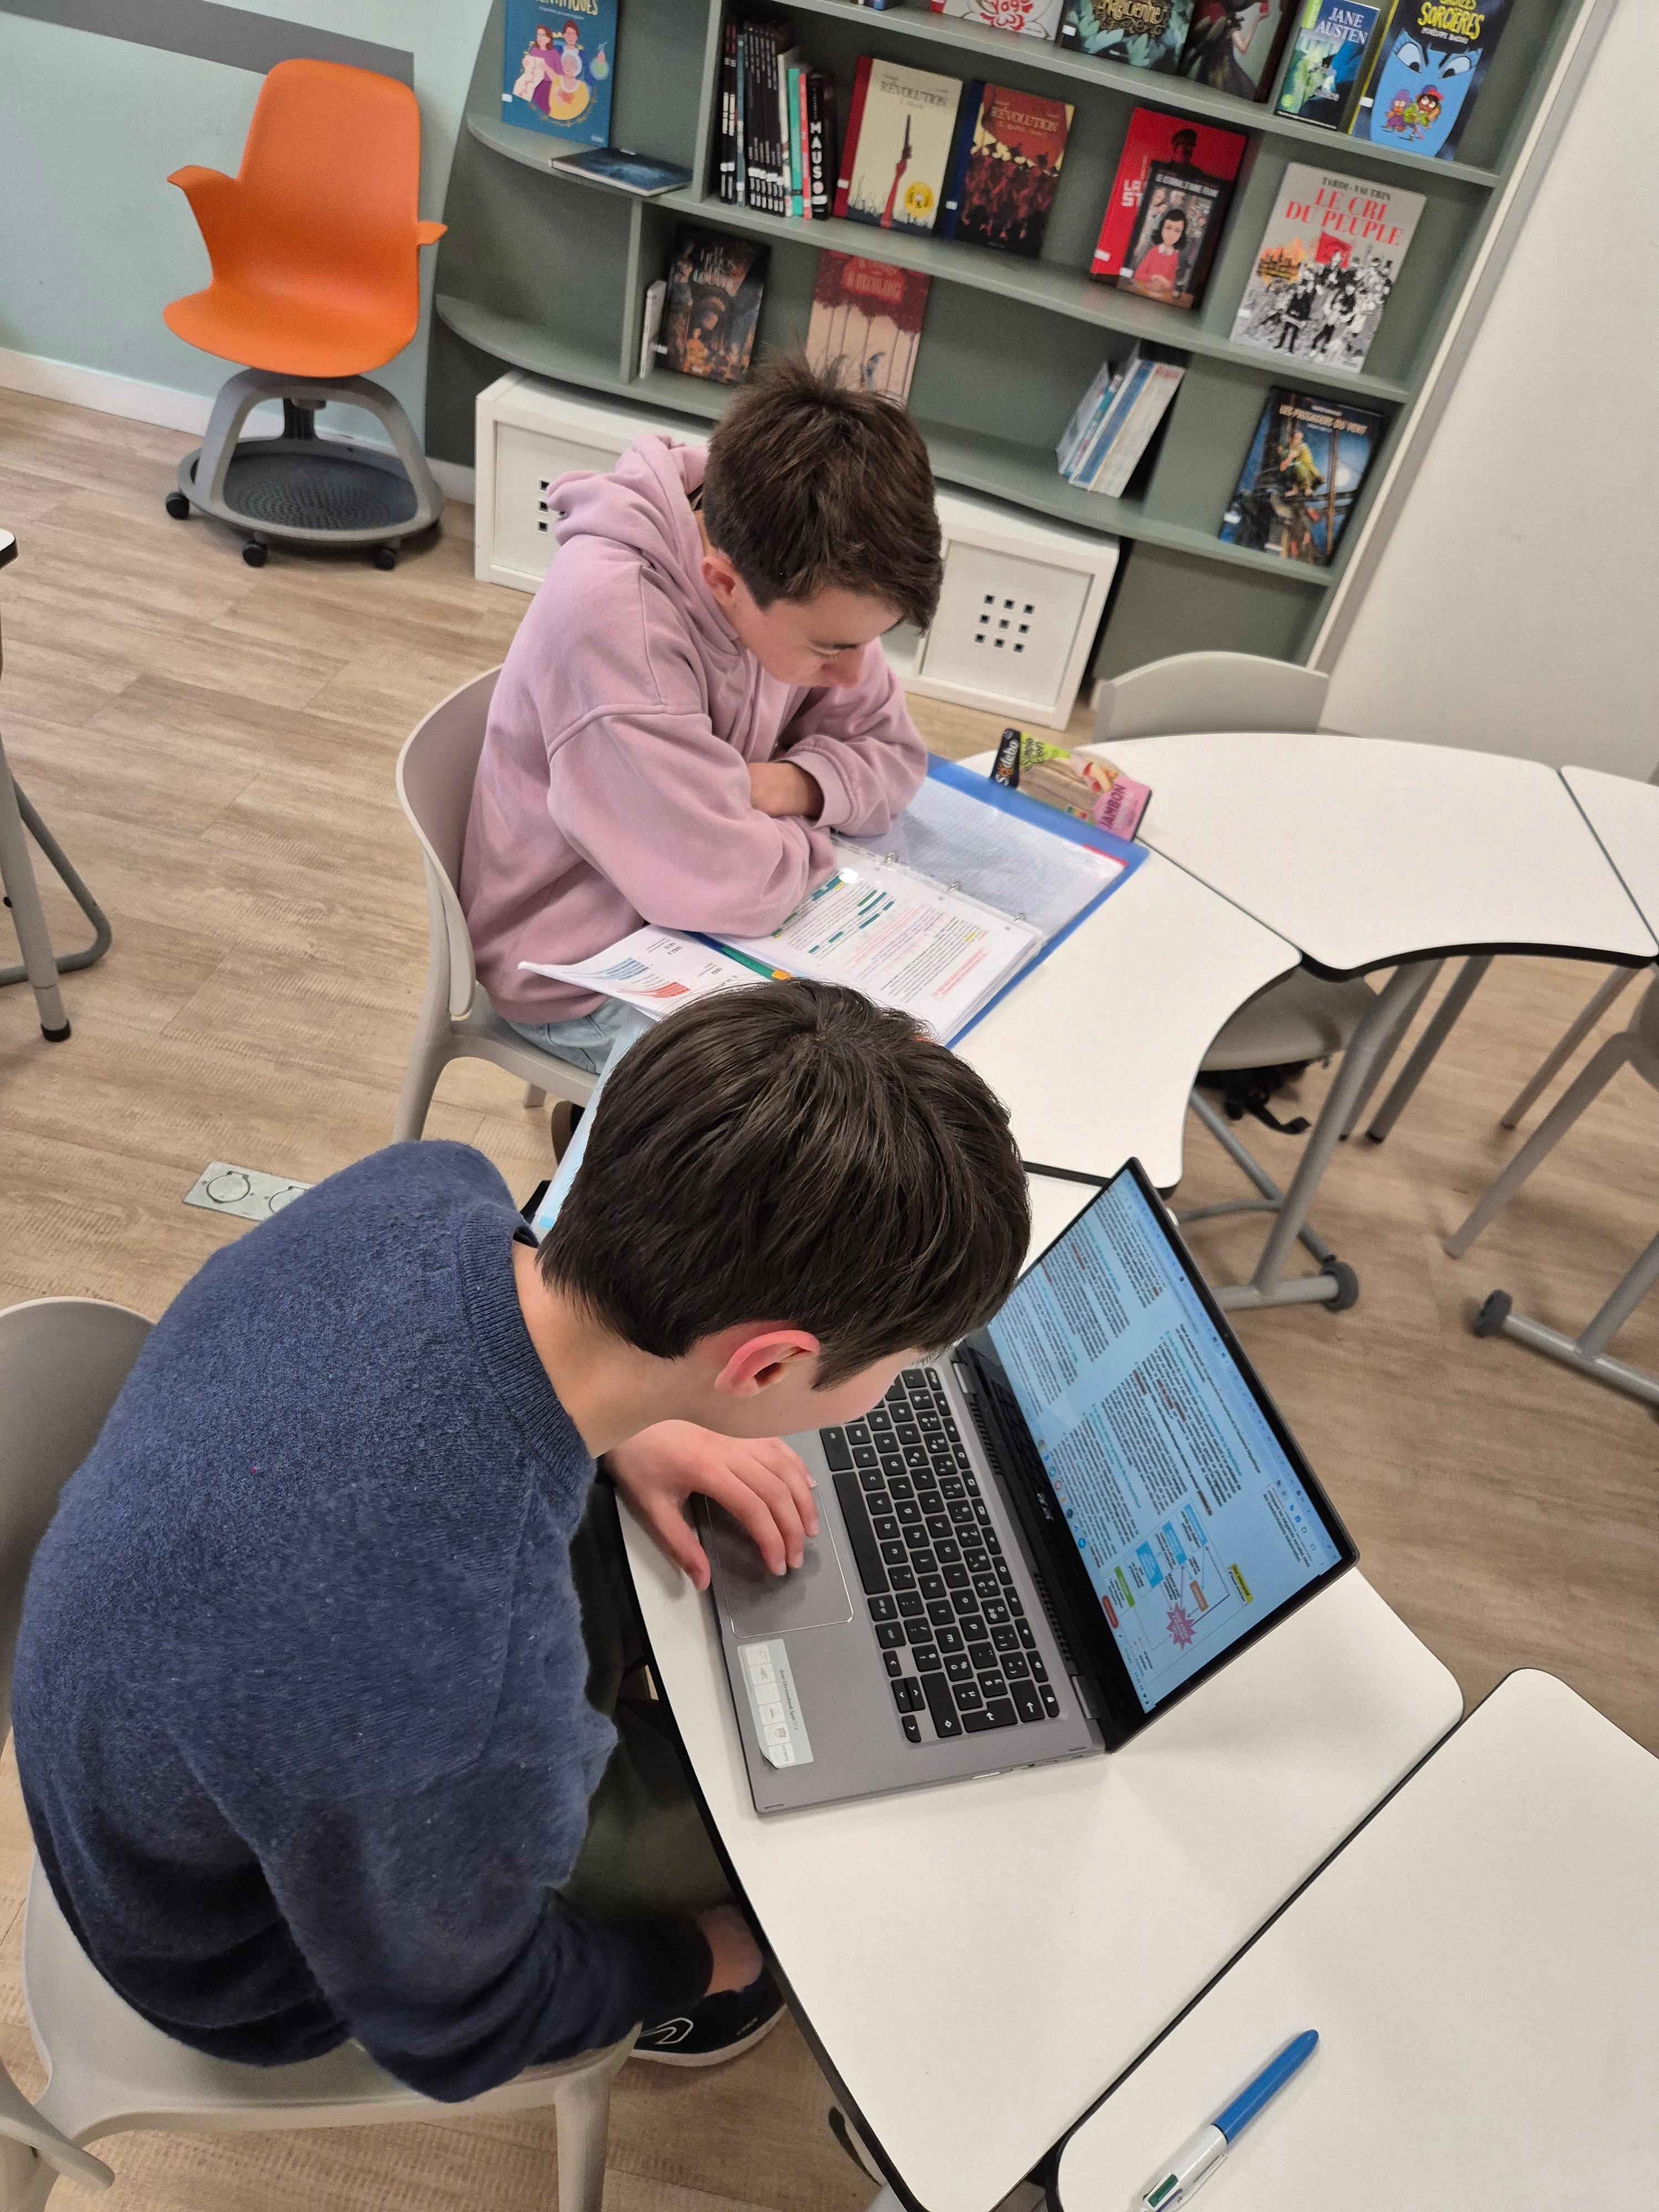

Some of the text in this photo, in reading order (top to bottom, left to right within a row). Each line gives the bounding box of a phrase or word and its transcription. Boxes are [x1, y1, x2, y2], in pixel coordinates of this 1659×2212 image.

[1316, 20, 1368, 45] AUSTEN
[1328, 7, 1364, 28] JANE
[810, 122, 822, 179] MAUS
[1315, 188, 1386, 221] LE CRI
[1321, 210, 1405, 247] PEUPLE
[1099, 784, 1126, 830] JAMBON
[946, 1634, 954, 1642] m
[781, 1679, 794, 1710] Chromebook
